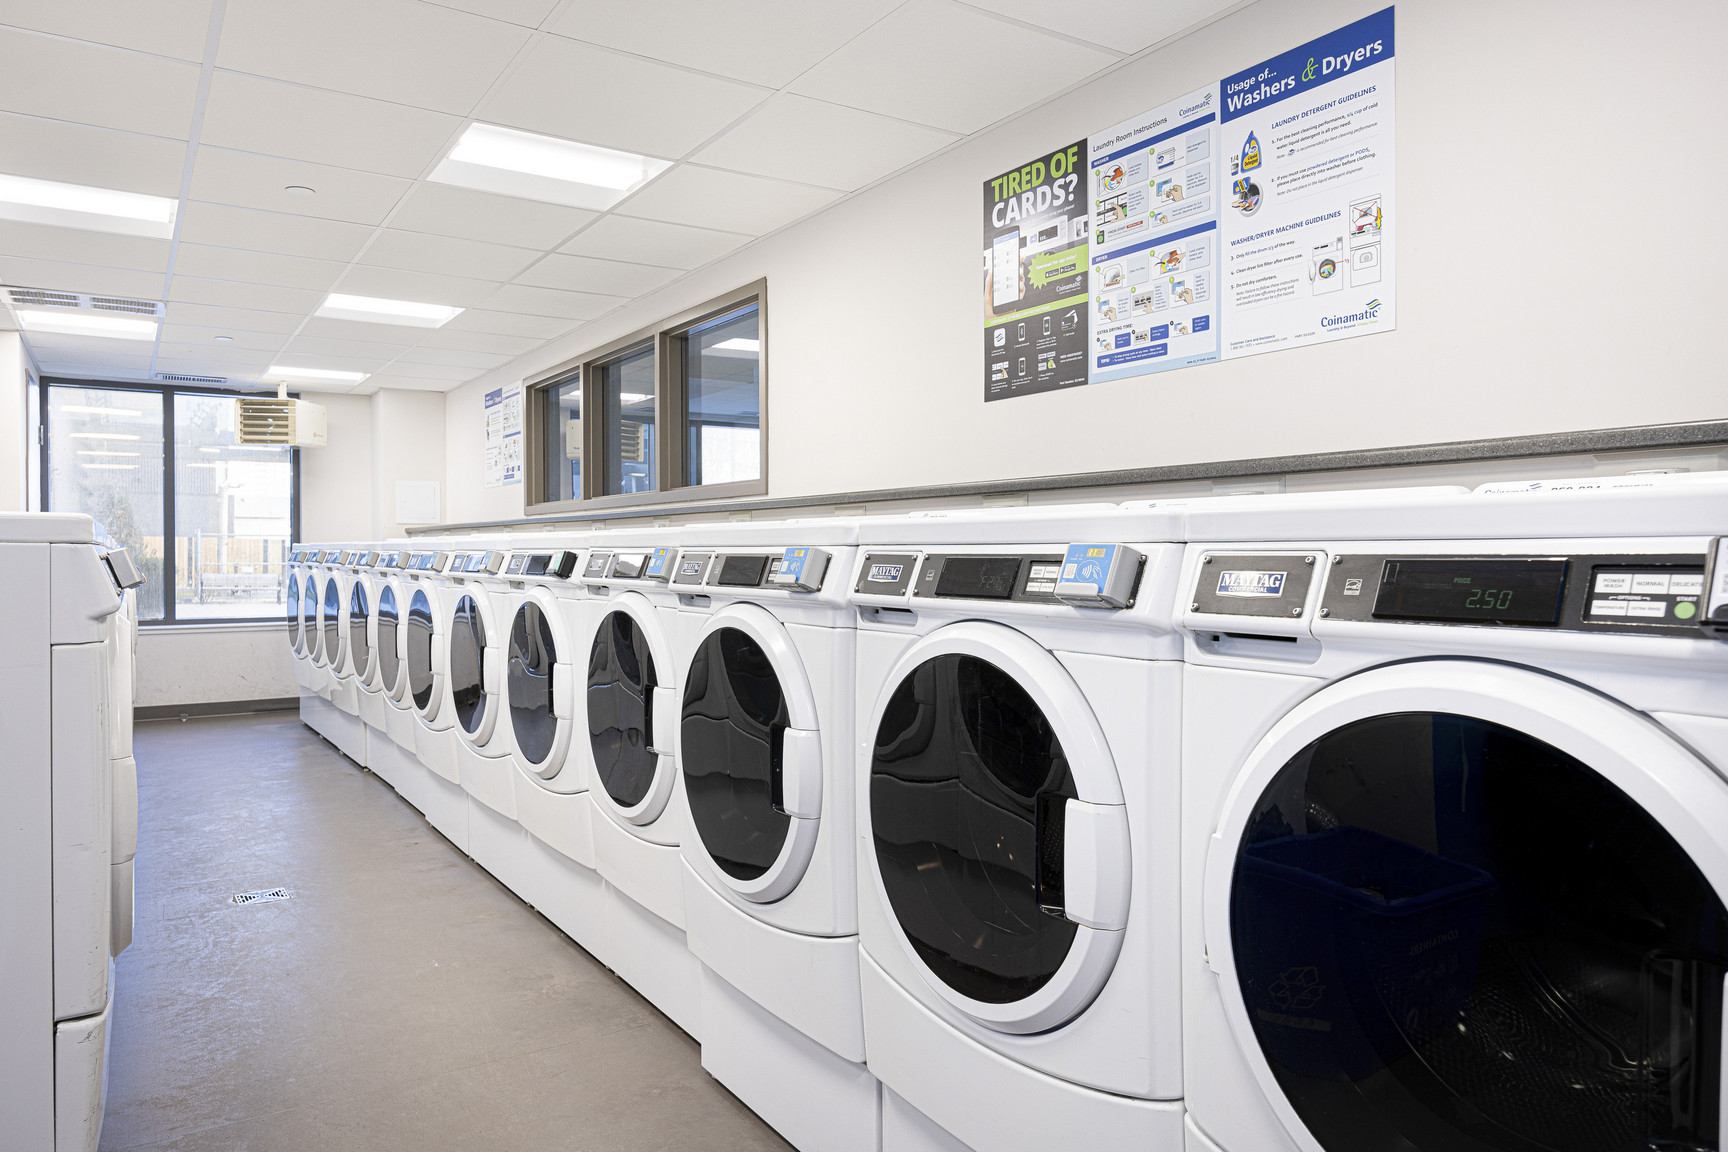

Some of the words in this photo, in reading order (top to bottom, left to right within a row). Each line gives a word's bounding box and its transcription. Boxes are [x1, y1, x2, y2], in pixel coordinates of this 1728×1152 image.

[1227, 75, 1296, 112] Washers
[1301, 57, 1319, 82] &
[1322, 39, 1383, 76] Dryers
[1227, 76, 1256, 94] Usage
[1258, 67, 1277, 82] of...
[1178, 100, 1211, 116] Coinamatic
[1271, 113, 1300, 130] LAUNDRY
[1301, 100, 1337, 119] DETERGENT
[1338, 85, 1377, 104] GUIDELINES
[1092, 138, 1115, 153] Laundry
[1116, 132, 1132, 143] Room
[1134, 117, 1168, 136] Instructions
[1300, 124, 1317, 134] cleaning
[1300, 132, 1320, 143] detergent
[1301, 171, 1316, 180] directly
[1326, 163, 1341, 172] washer
[1342, 158, 1356, 166] before
[1328, 153, 1349, 164] detergent
[991, 161, 1046, 202] TIRED
[1050, 145, 1078, 178] OF
[992, 173, 1078, 228] CARDS?
[1230, 229, 1274, 247] WASHER/DRYER
[1275, 220, 1304, 234] MACHINE
[1304, 210, 1342, 226] GUIDELINES
[1056, 281, 1081, 292] Coinamatic
[1320, 309, 1378, 328] Coinamatic
[872, 566, 900, 576] MAYTAG
[1222, 574, 1283, 588] MAYTAG
[1466, 589, 1512, 610] 2.50
